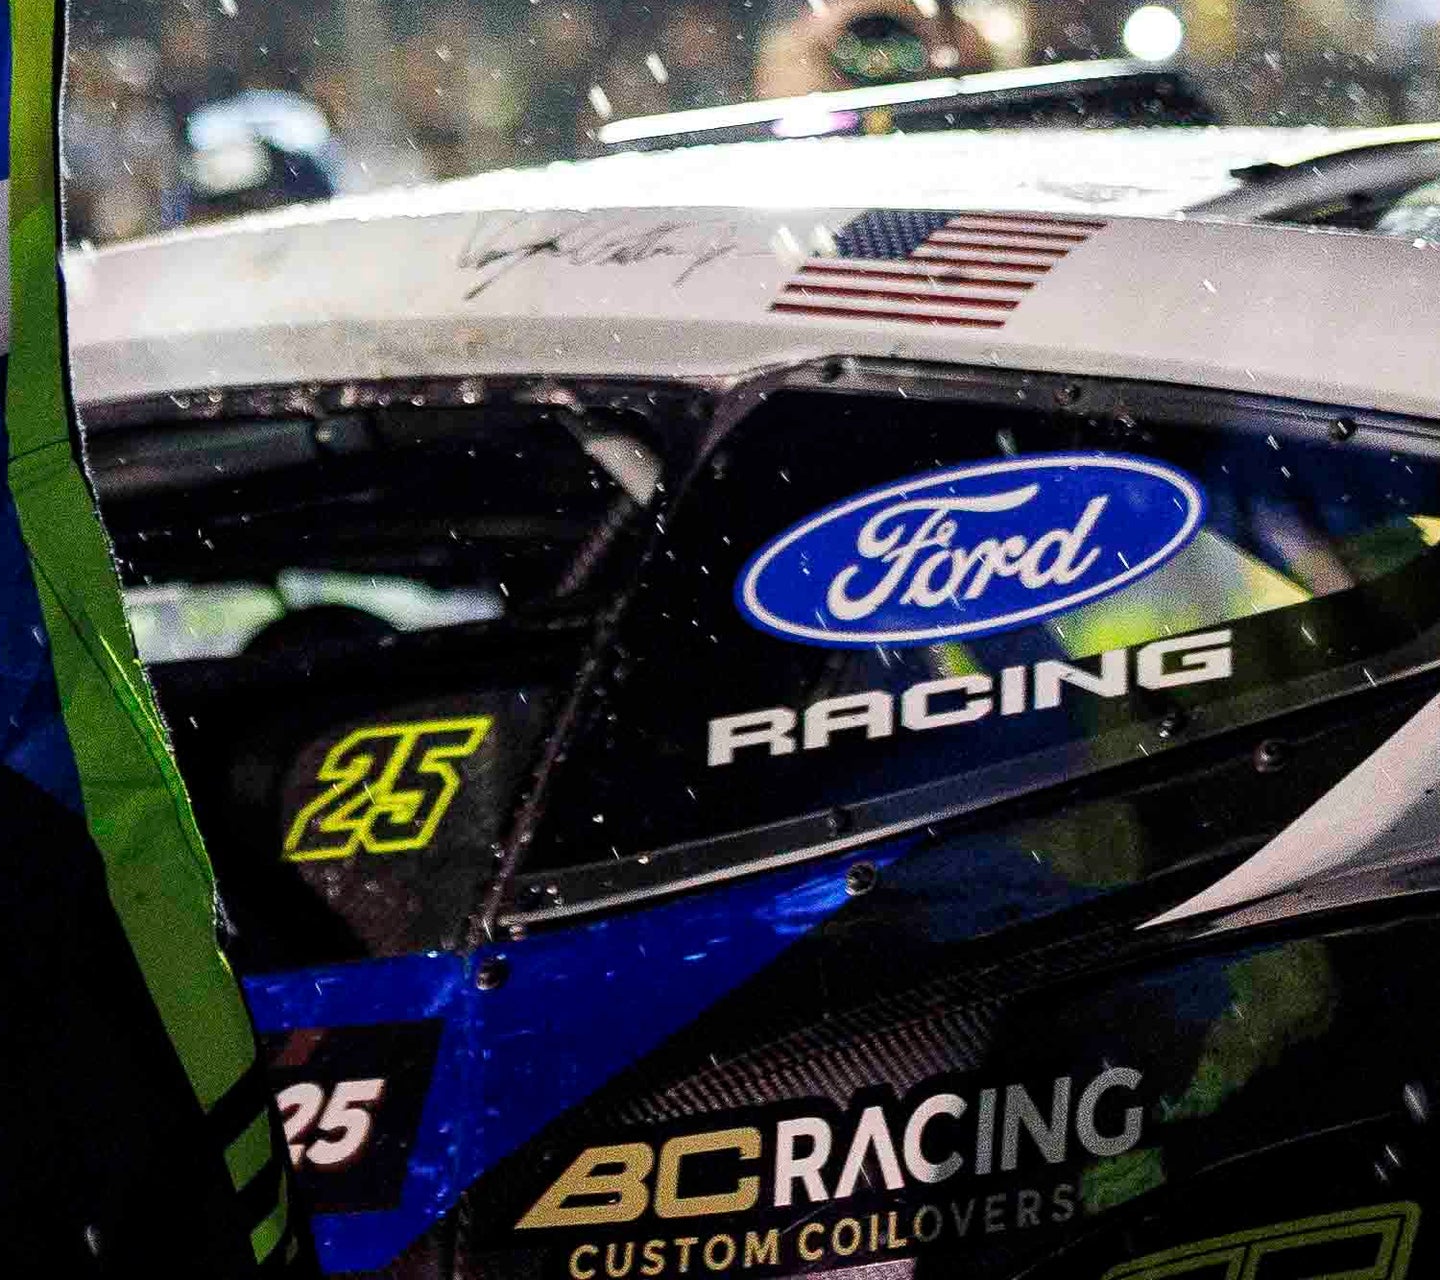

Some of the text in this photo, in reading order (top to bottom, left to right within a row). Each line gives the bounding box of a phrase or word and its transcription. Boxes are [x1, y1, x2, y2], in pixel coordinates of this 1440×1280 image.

[826, 483, 1110, 621] Ford
[706, 628, 1234, 767] RACING
[282, 715, 495, 862] 25
[274, 1076, 388, 1169] 25
[567, 1231, 780, 1280] CUSTOM
[796, 1183, 1077, 1262] COILOVERS
